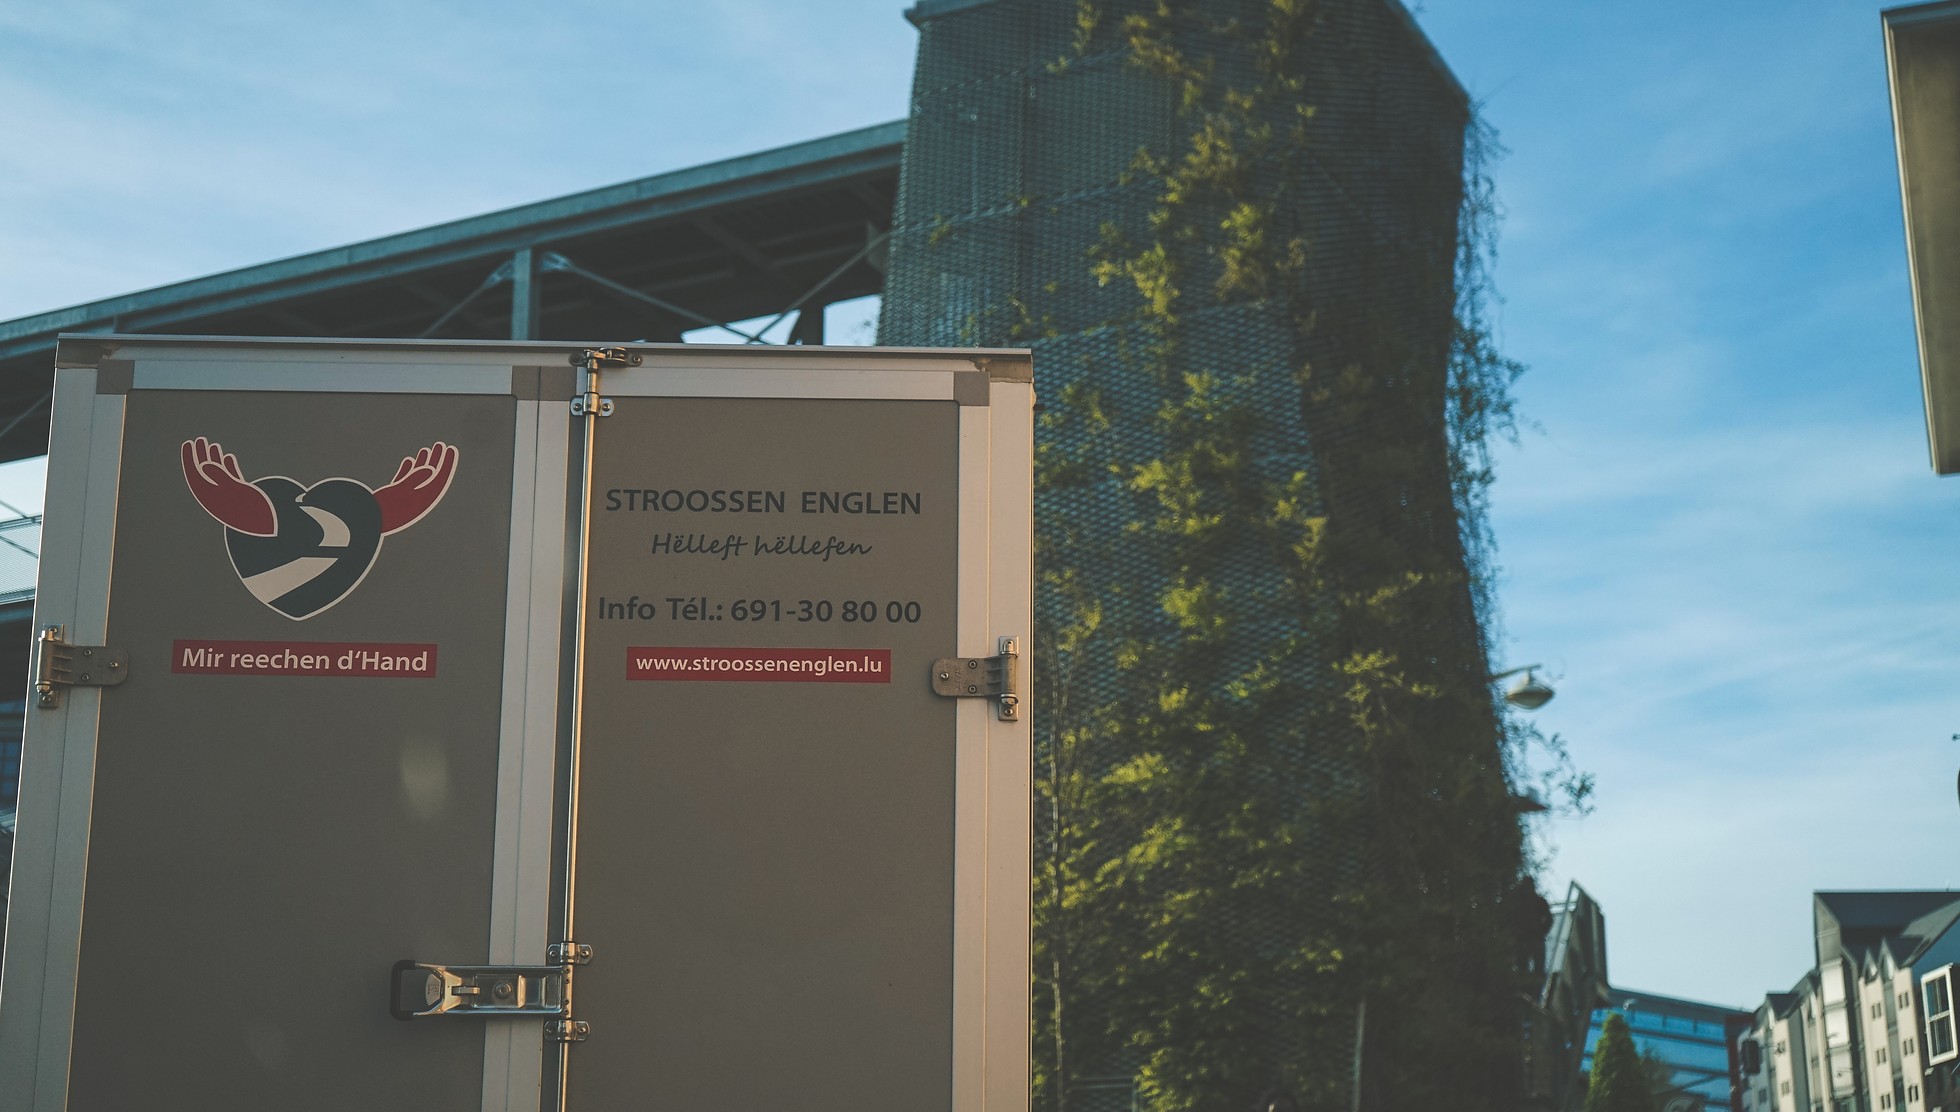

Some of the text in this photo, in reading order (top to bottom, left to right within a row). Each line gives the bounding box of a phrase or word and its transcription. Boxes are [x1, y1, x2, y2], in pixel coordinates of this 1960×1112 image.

[606, 489, 921, 514] STROOSSEN ENGLEN
[651, 533, 872, 562] Hëlleft hëllefen
[599, 596, 922, 623] Info Tél.: 691-30 80 00
[182, 648, 223, 668] Mir
[230, 649, 330, 670] reechen
[636, 656, 882, 676] www.stroossenenglen.lu
